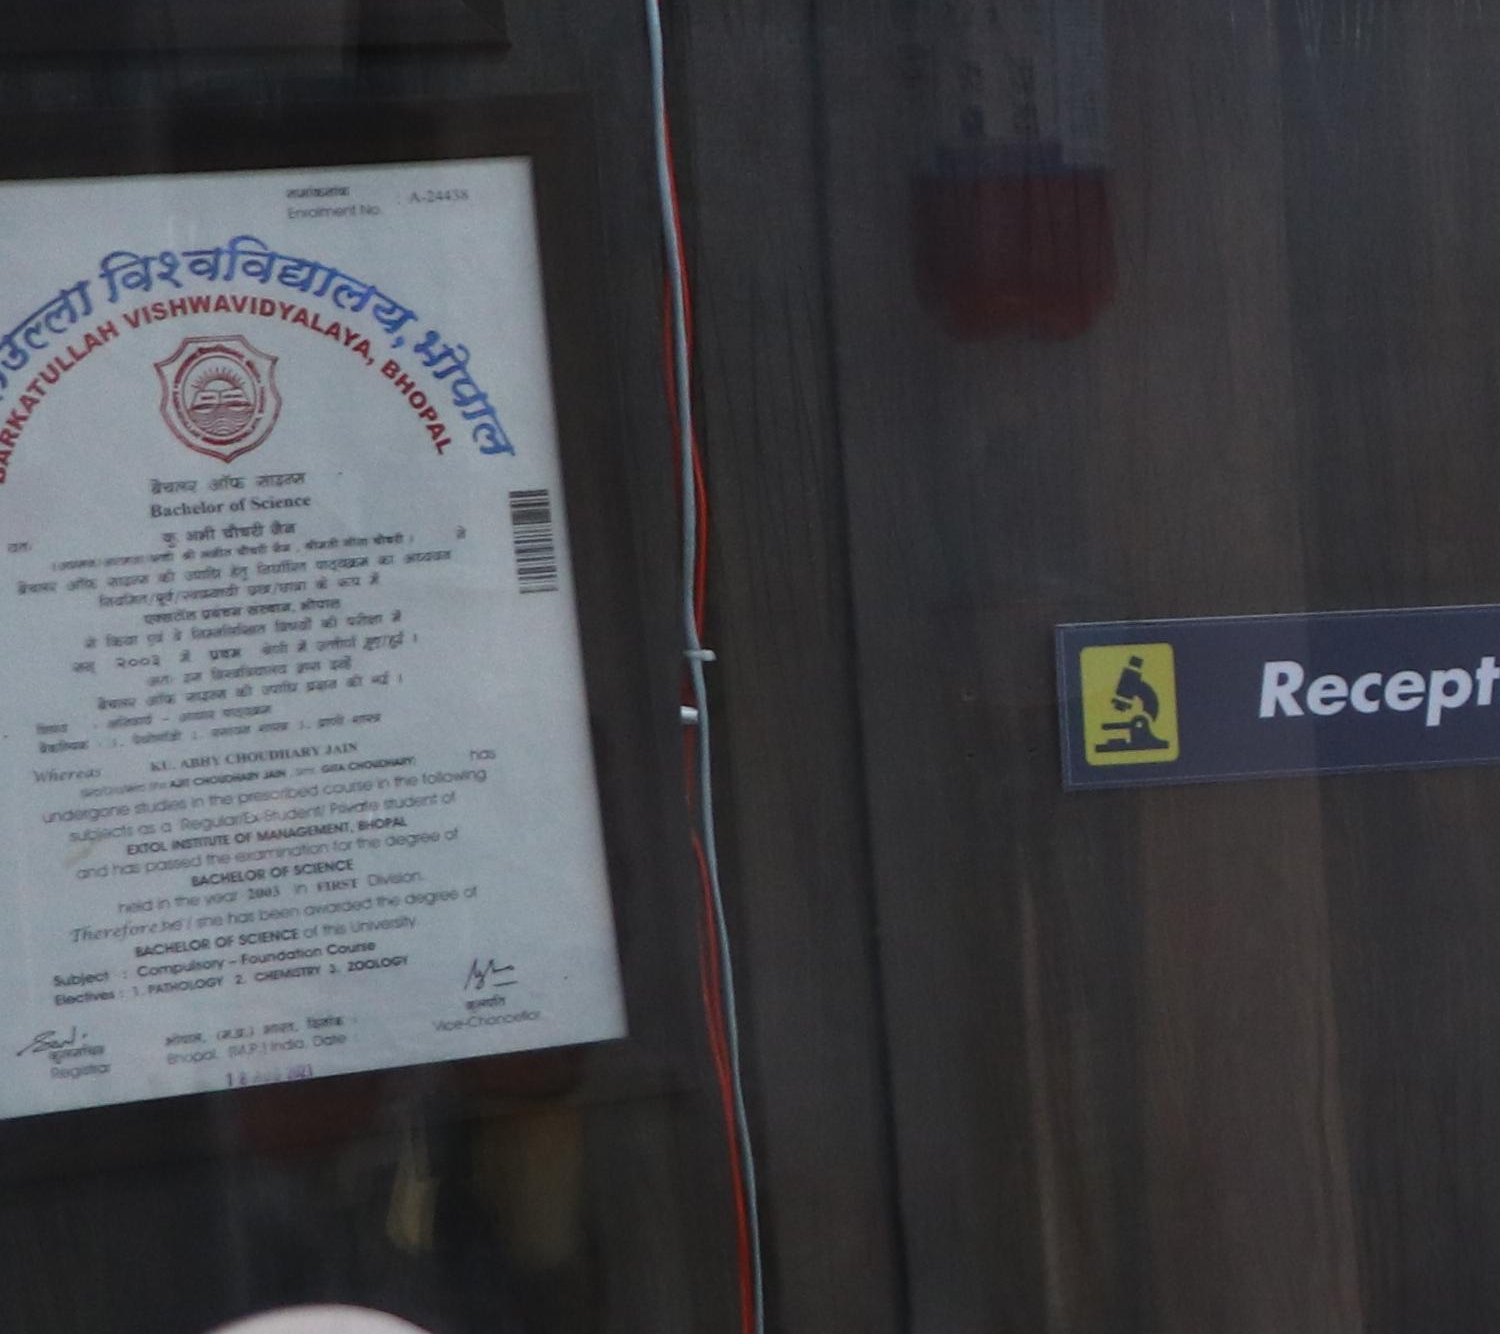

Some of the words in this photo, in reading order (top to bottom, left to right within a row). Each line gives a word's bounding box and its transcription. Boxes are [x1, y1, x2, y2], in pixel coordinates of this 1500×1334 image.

[122, 294, 377, 368] VISHWAVIDYALAYA,
[380, 358, 453, 456] BHOPAL
[150, 499, 225, 519] Bachelor
[229, 497, 247, 514] of
[250, 492, 312, 514] Science
[191, 869, 267, 888] BACHELOR
[270, 866, 290, 880] OF
[294, 858, 354, 876] SCIENCE
